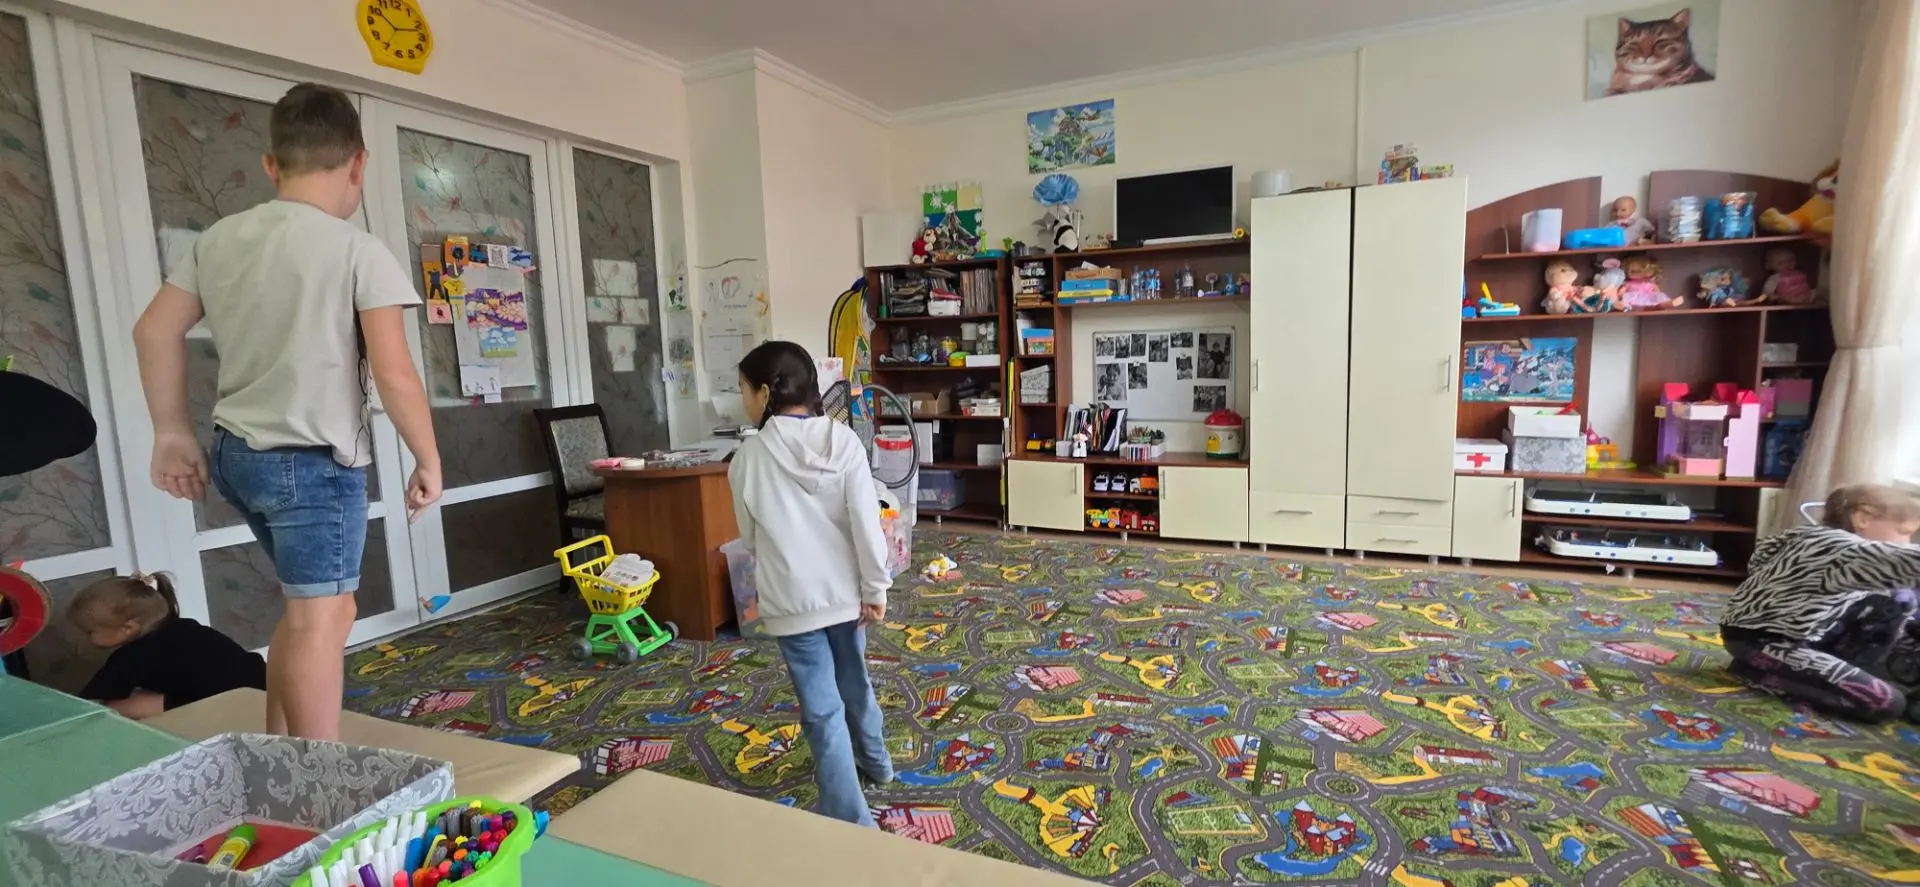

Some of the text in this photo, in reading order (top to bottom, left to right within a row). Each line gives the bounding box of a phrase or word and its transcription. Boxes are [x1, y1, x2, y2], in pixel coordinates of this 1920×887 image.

[368, 5, 382, 16] 10
[390, 0, 402, 11] 12
[406, 8, 412, 17] 1
[418, 32, 427, 42] 3
[383, 41, 390, 50] 7
[415, 43, 424, 52] 4
[395, 49, 404, 59] 6
[407, 49, 416, 59] 5
